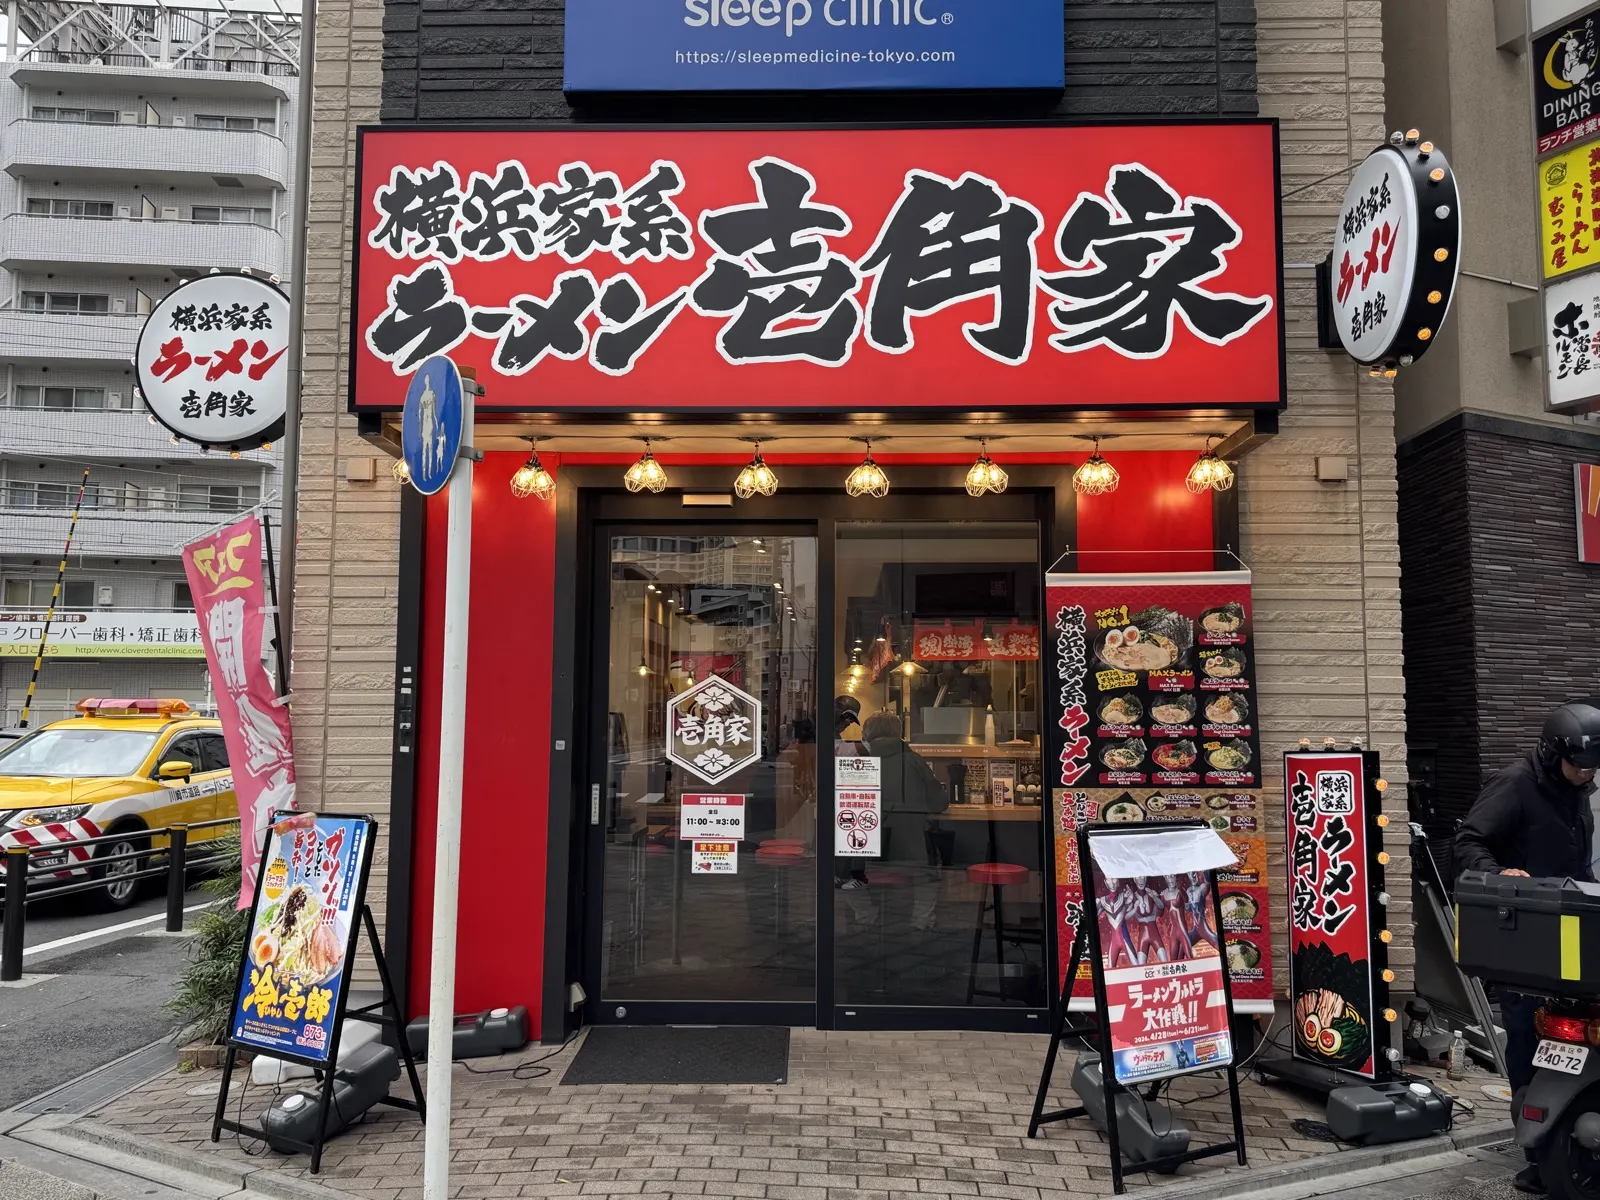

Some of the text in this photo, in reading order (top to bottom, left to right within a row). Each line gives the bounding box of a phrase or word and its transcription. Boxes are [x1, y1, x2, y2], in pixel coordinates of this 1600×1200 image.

[684, 0, 813, 36] sleep
[675, 48, 956, 66] https://sleepmedicine-tokyo.com
[1543, 81, 1600, 119] DINING
[1556, 102, 1591, 128] BAR
[1539, 116, 1600, 152] ランチ営業
[366, 160, 694, 262] 横浜家系
[1343, 173, 1391, 243] 横浜家系
[1569, 182, 1590, 256] らーめん
[1547, 196, 1568, 269] むつみ屋
[691, 156, 1273, 366] 壱角家
[1337, 216, 1401, 309] ラーメン
[169, 302, 272, 332] 横浜家系
[365, 260, 690, 376] ラーメン
[1351, 291, 1388, 342] 壱角家
[150, 336, 289, 383] ラーメン
[180, 389, 257, 419] 壱角家
[1149, 669, 1194, 677] MAXラーメン
[675, 713, 752, 746] 壱角家
[686, 817, 708, 825] 11:00
[1291, 770, 1322, 933] 壱角家
[1320, 813, 1356, 937] ラーメン
[1128, 976, 1204, 1009] ラーメンウルトラ
[1142, 1000, 1199, 1032] 大作戦!!
[1544, 1053, 1582, 1071] 40-72
